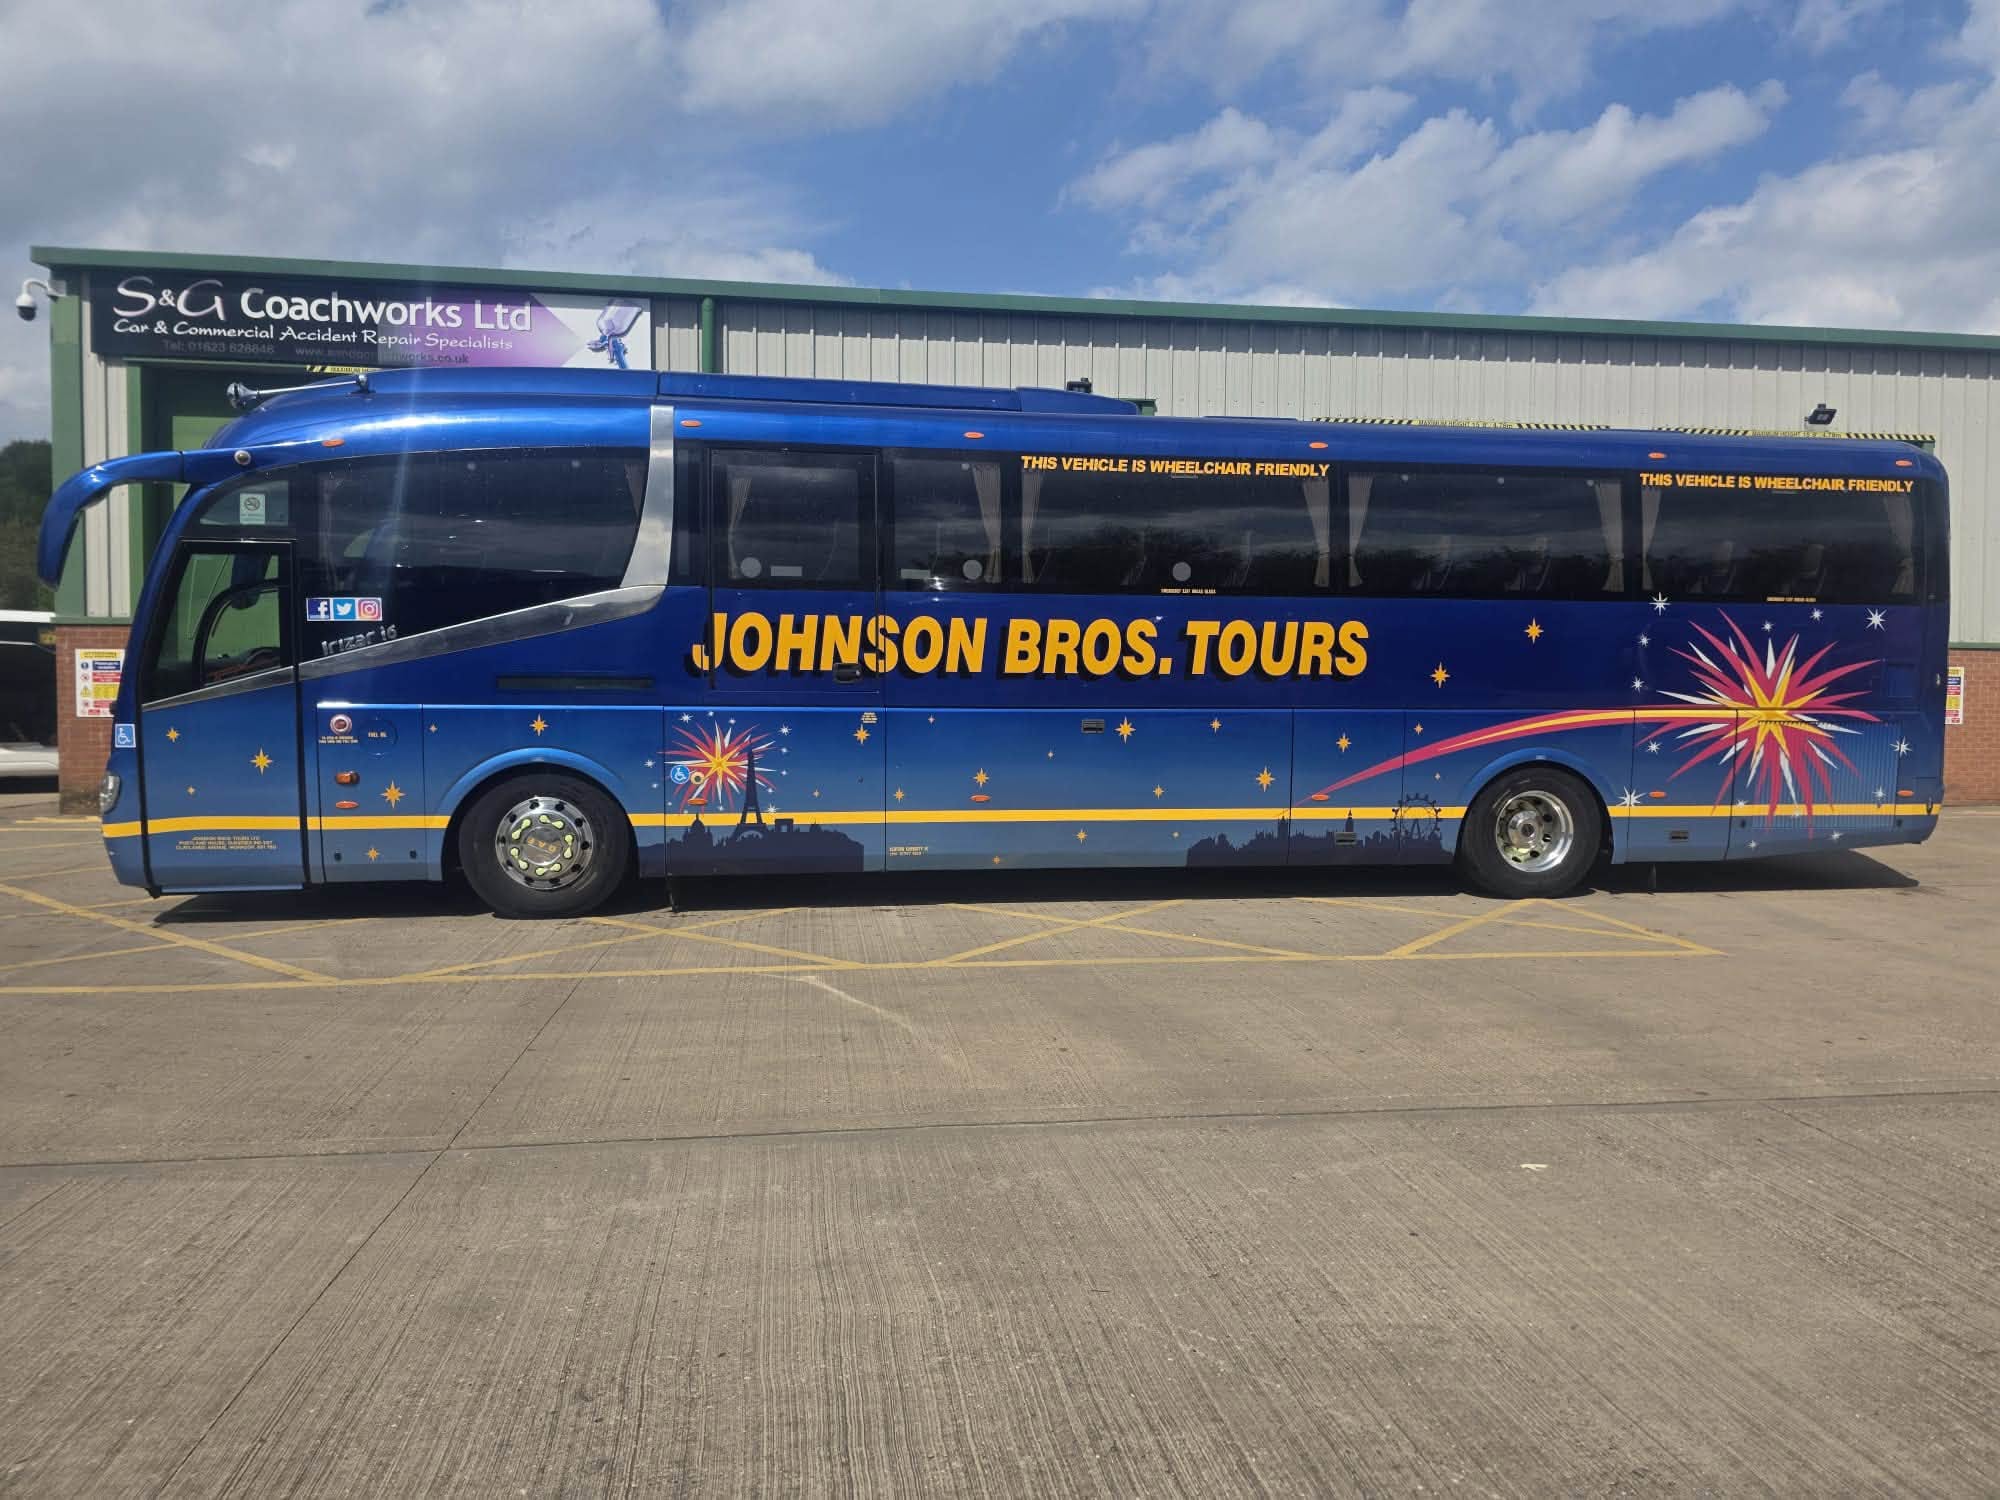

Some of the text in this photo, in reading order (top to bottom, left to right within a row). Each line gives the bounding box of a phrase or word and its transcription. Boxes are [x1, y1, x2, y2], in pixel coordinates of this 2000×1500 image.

[113, 276, 532, 331] S&G Coachworks Ltd
[113, 318, 513, 350] Car & Commercial Accident Repair Specialists
[1021, 455, 1330, 477] THIS VEHICLE IS WHEELCHAIR FRIENDLY
[1640, 473, 1914, 492] THIS VEHICLE IS WHEELCHAIR FRIENDLY
[692, 611, 1369, 677] JOHNSON BROS. TOURS
